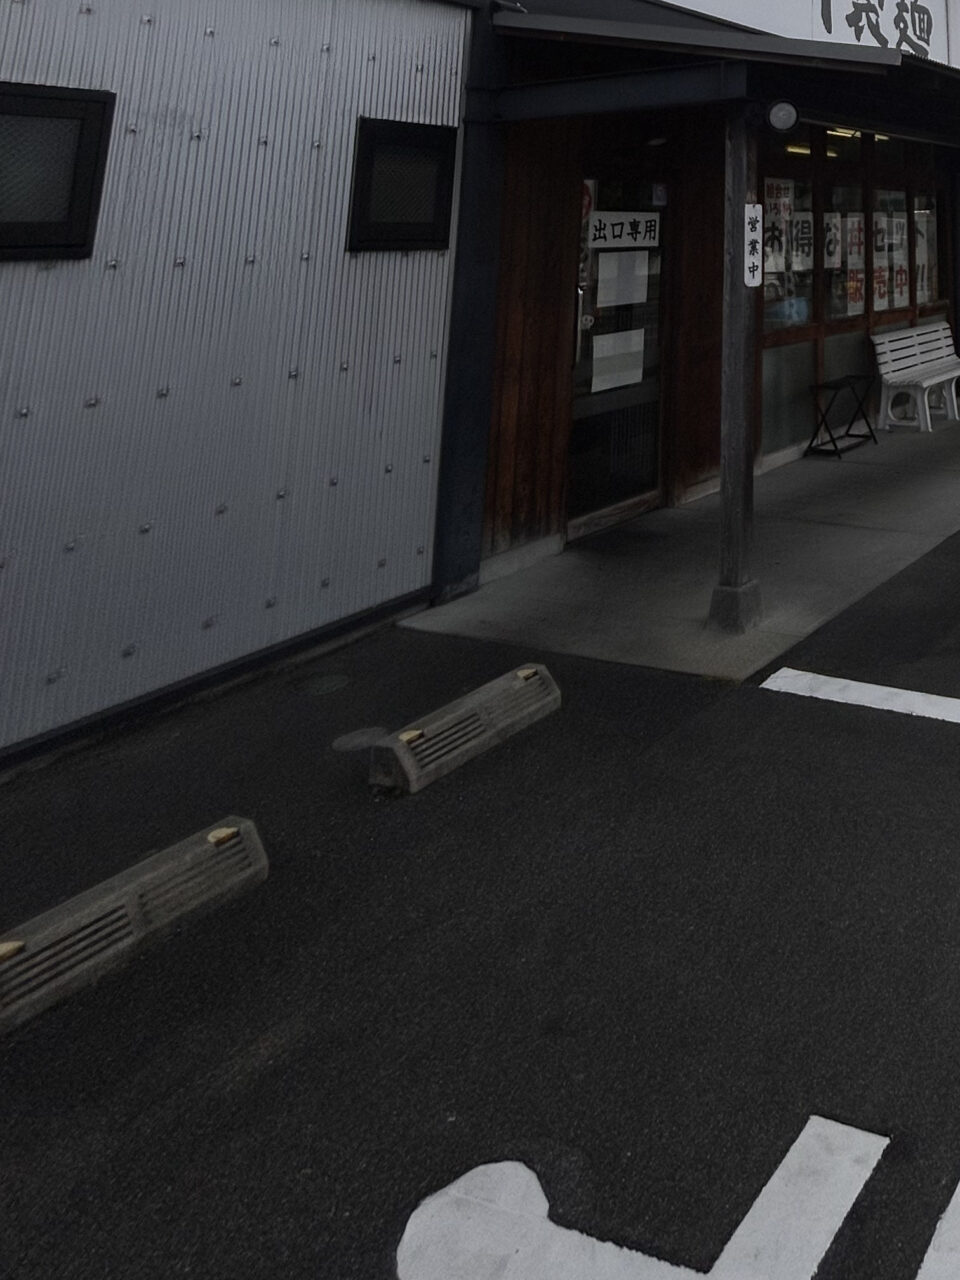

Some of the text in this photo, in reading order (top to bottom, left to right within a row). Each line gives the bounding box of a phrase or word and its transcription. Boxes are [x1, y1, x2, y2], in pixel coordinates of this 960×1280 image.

[592, 218, 657, 243] 出口専用
[747, 216, 760, 280] 営業中
